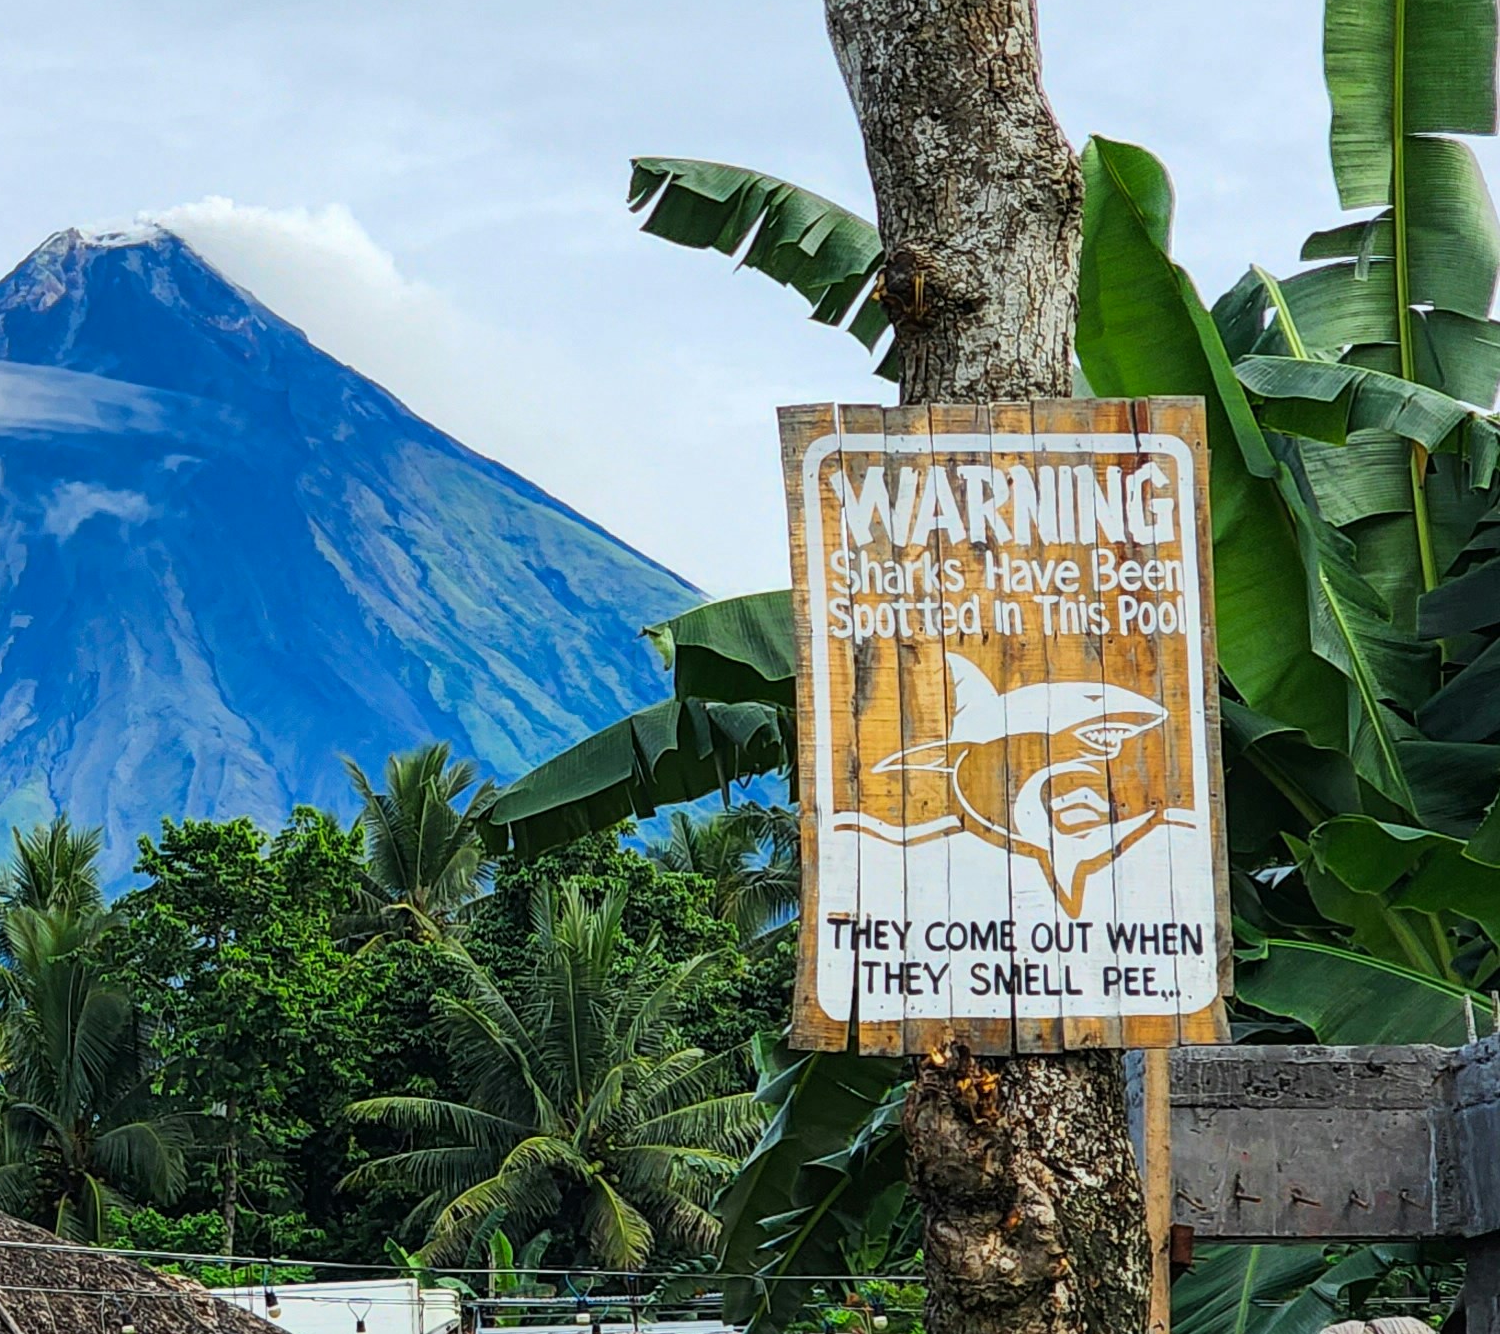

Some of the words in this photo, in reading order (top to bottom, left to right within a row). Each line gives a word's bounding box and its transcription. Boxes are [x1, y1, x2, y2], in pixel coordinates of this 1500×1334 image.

[829, 462, 1174, 546] WARNING
[830, 550, 962, 595] Sharks
[985, 551, 1079, 593] Have
[1092, 549, 1184, 592] Been
[828, 595, 981, 643] Spotted
[1033, 595, 1110, 636] This
[1119, 595, 1187, 636] Pool
[827, 918, 911, 950] THEY
[925, 920, 1017, 952] COME
[1031, 921, 1093, 953] OUT
[1105, 922, 1204, 955] WHEN
[861, 960, 951, 995] THEY
[969, 962, 1083, 996] SMELL
